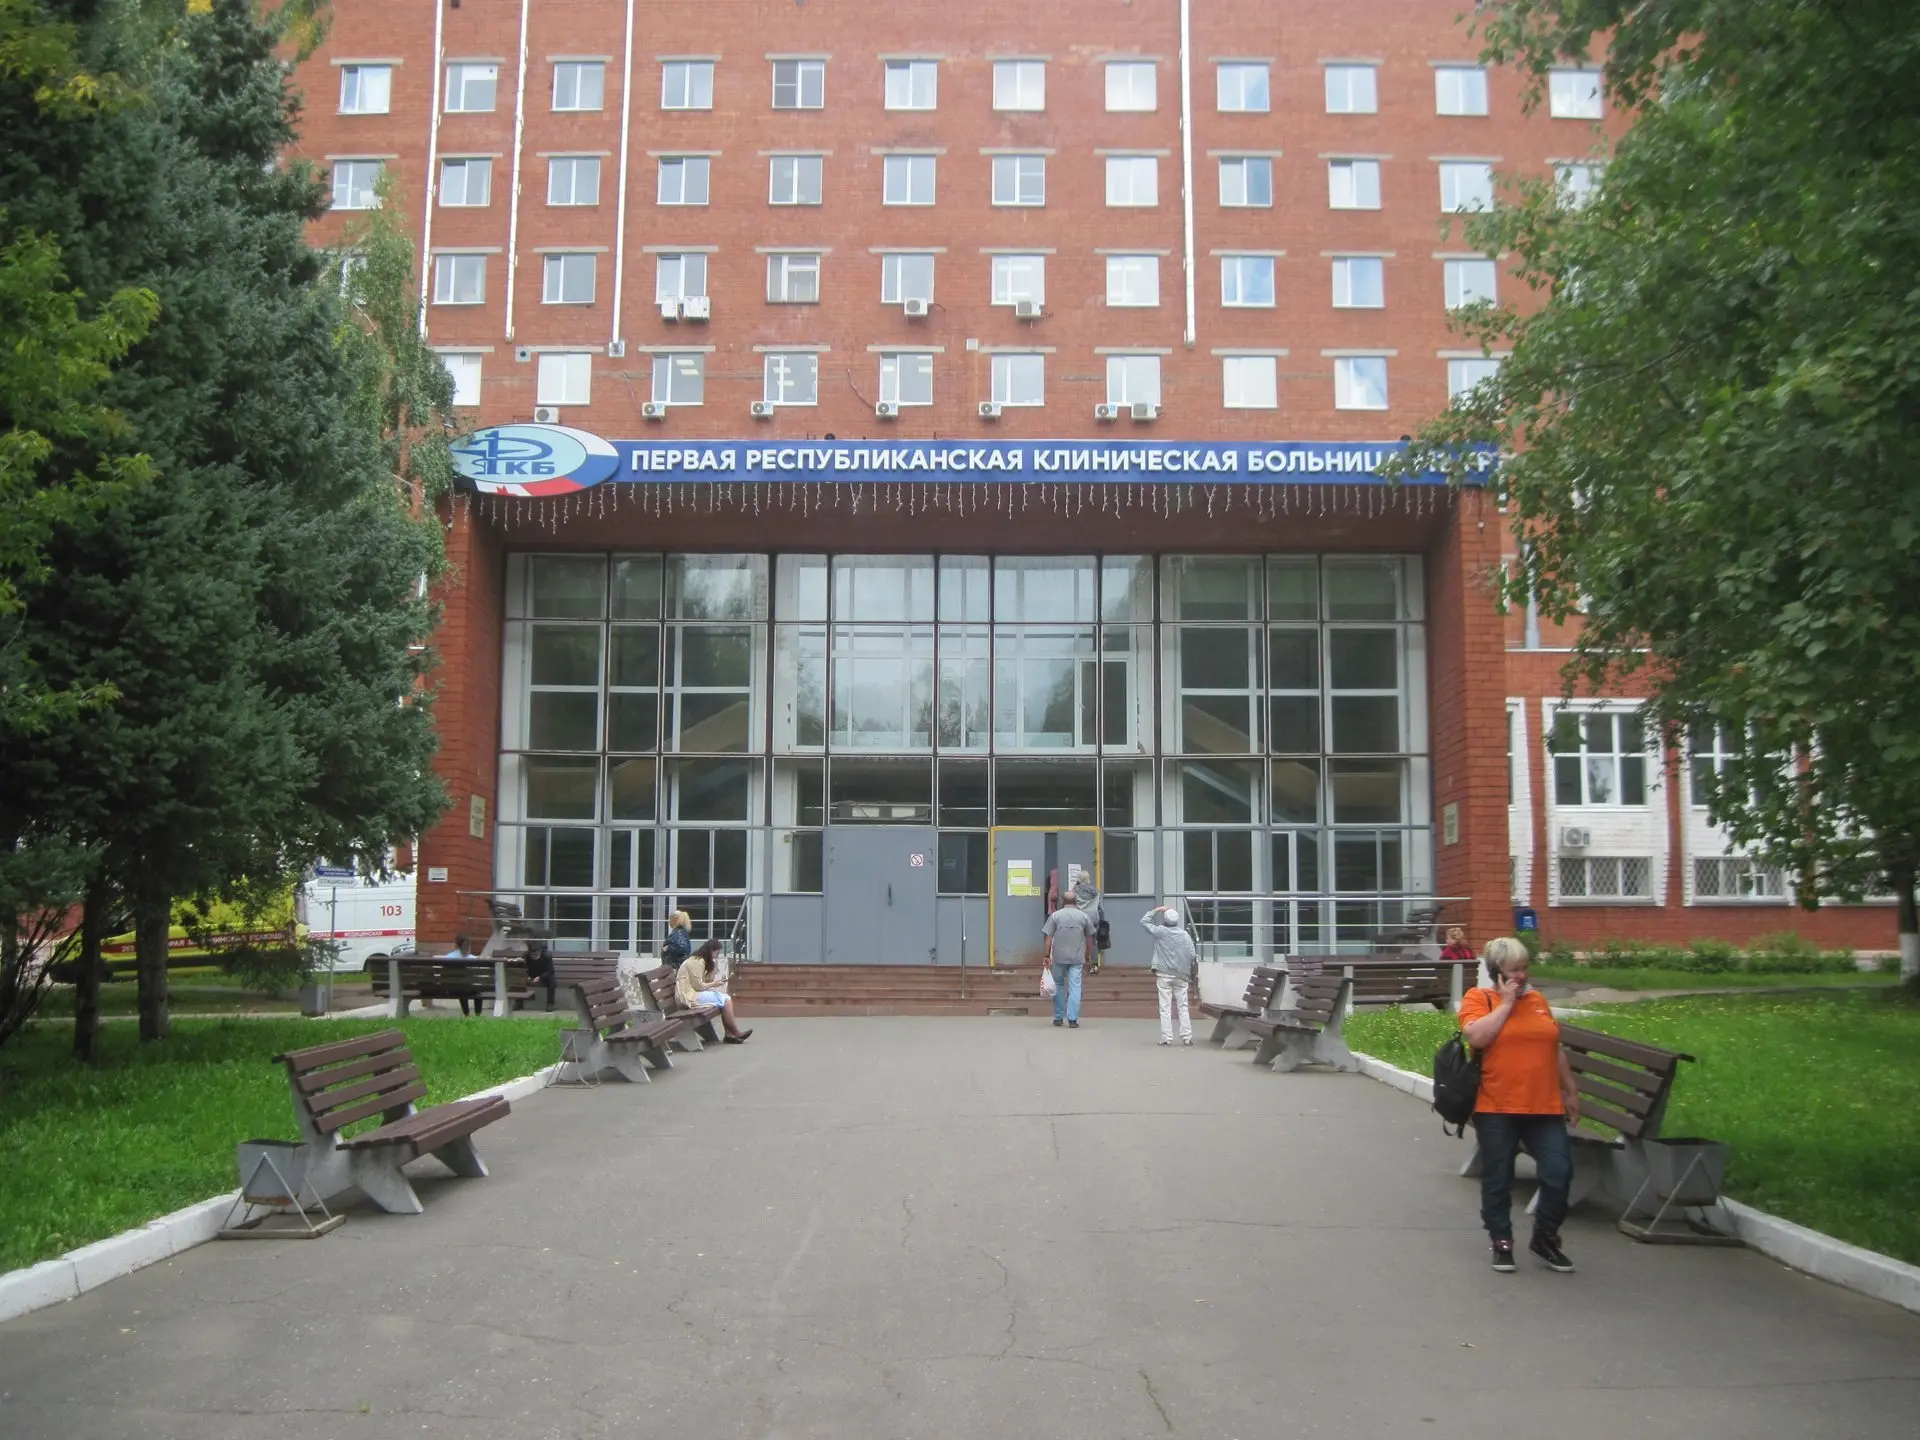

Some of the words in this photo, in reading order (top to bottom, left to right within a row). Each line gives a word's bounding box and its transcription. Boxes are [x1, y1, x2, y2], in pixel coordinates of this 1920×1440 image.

[631, 449, 736, 470] ПЕРВАЯ
[745, 448, 1023, 471] РЕСПУБЛИКАНСКАЯ
[1033, 449, 1238, 472] КЛИНИЧЕСКАЯ
[380, 905, 402, 916] 103
